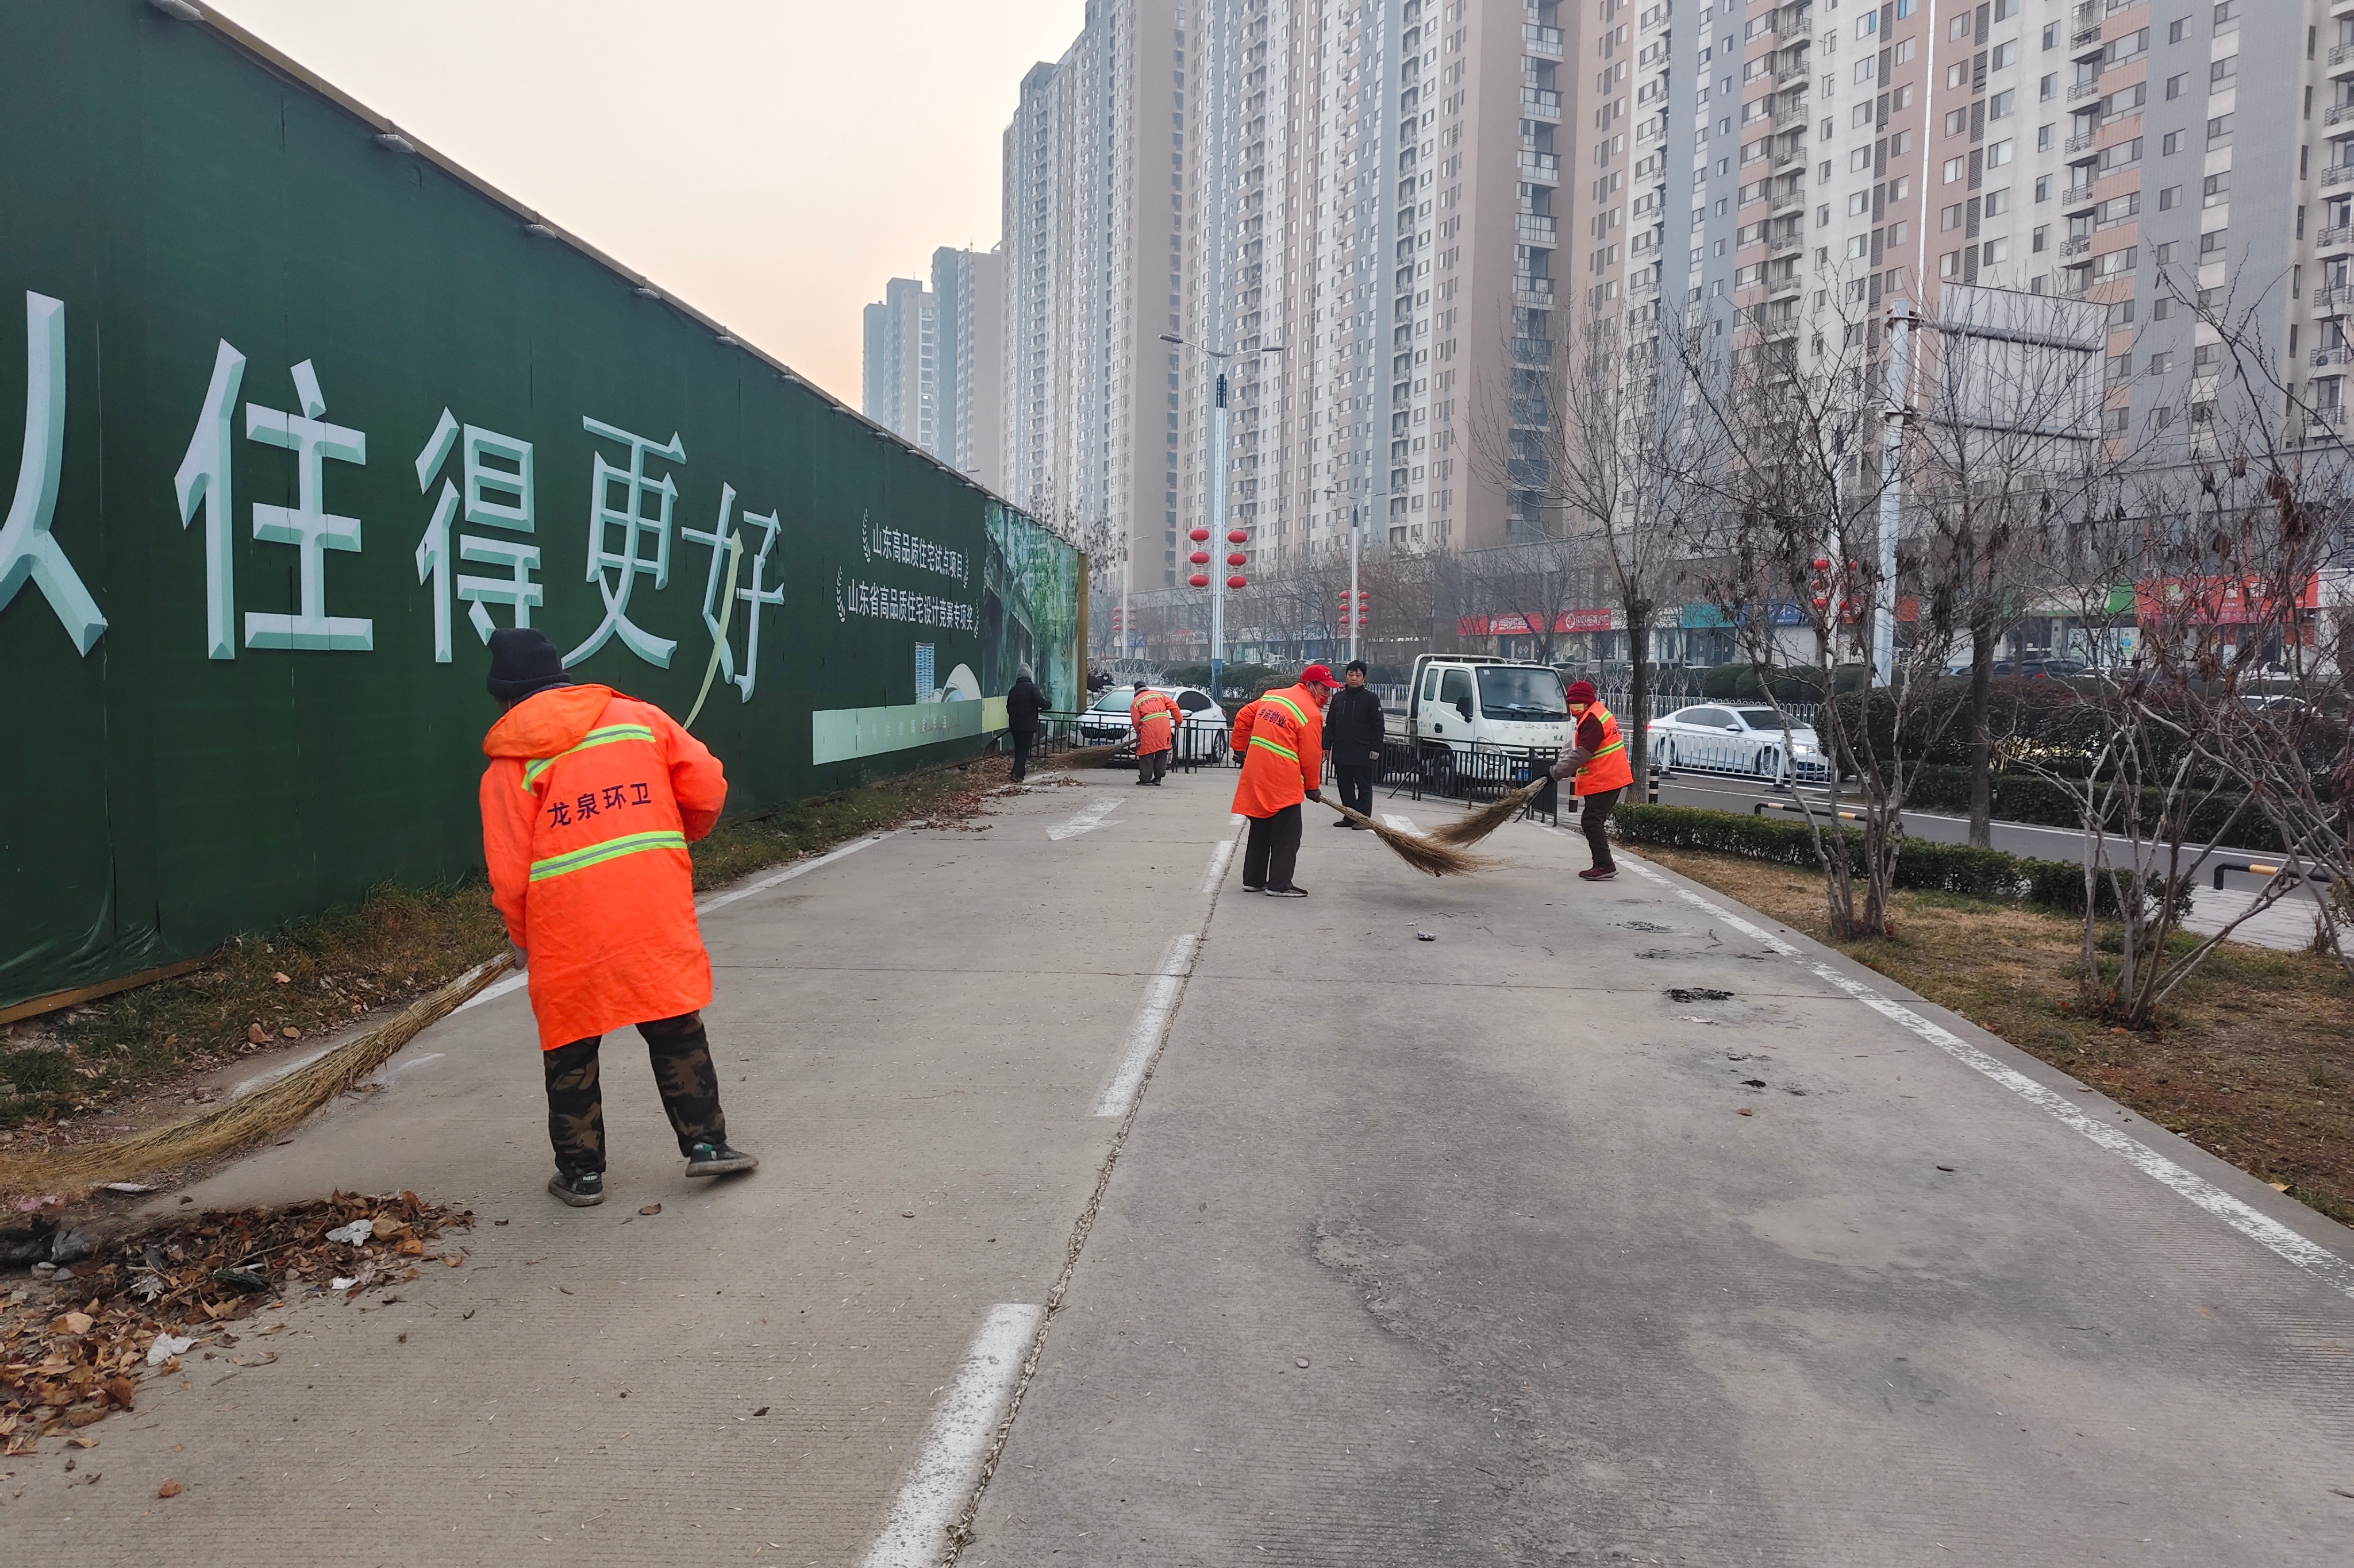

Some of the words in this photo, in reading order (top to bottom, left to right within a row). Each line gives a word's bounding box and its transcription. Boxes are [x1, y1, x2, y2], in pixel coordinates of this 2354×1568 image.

[872, 522, 963, 580] 山东高品质住宅试点项目
[848, 578, 974, 631] 山东省高品质住宅设计竞赛专项奖
[547, 783, 652, 829] 龙泉环卫
